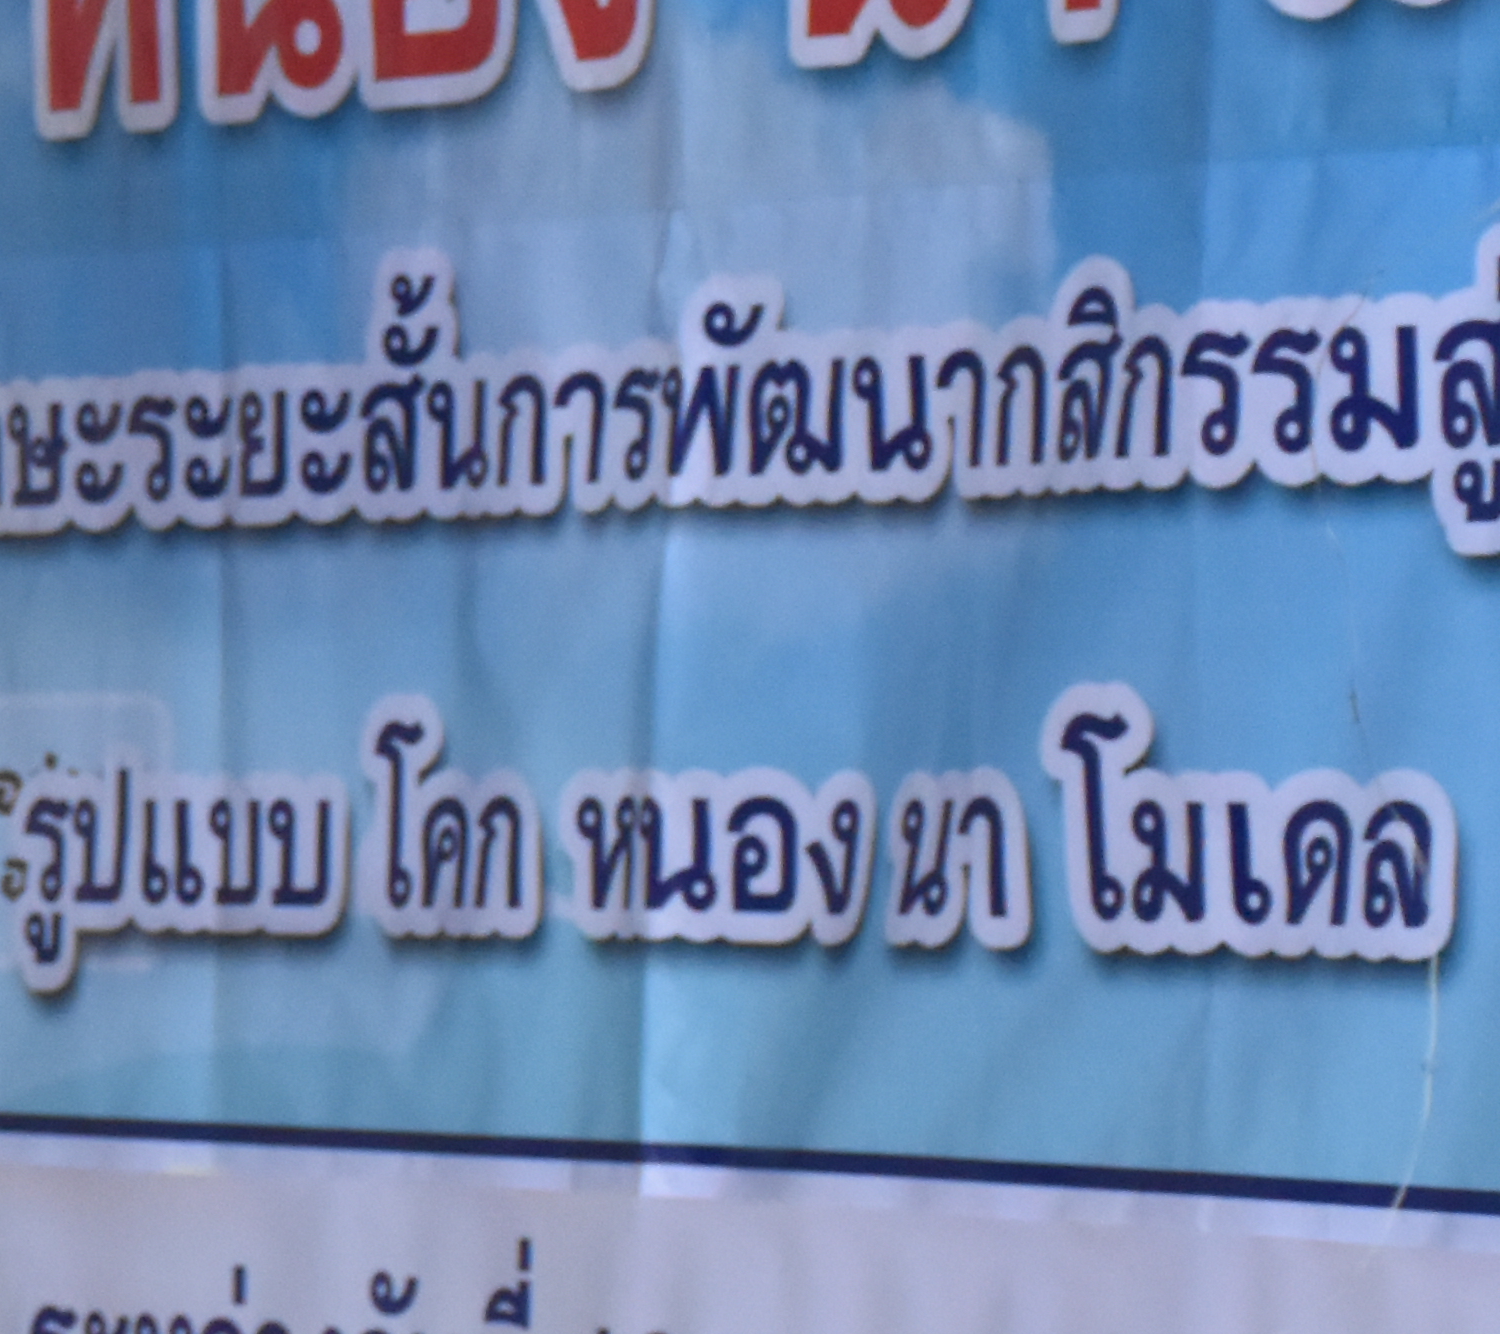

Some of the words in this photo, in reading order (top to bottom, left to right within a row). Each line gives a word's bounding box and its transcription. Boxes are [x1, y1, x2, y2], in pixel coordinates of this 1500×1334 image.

[25, 768, 331, 964] รูปแบบ
[374, 721, 525, 911] โคก
[575, 795, 861, 919] หนอง
[901, 794, 1007, 919] นา
[1060, 713, 1429, 930] โมเดล
